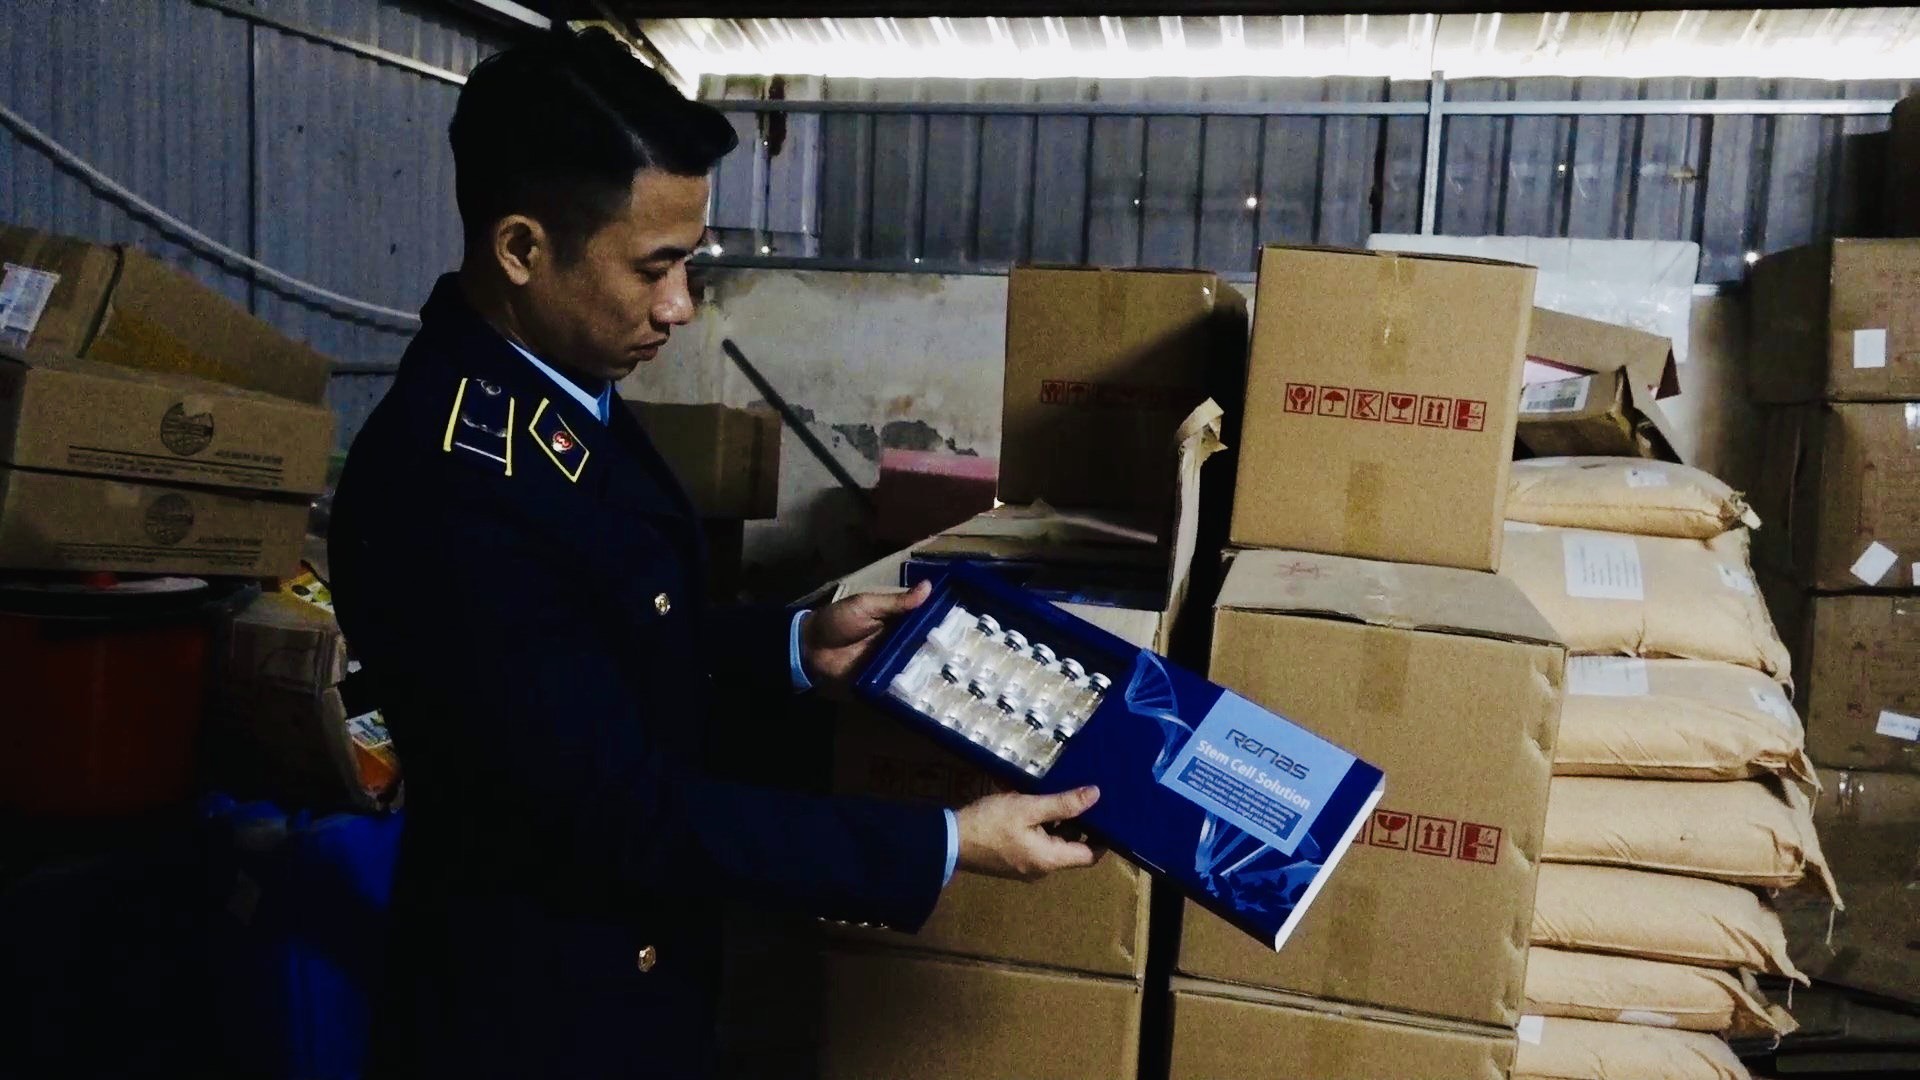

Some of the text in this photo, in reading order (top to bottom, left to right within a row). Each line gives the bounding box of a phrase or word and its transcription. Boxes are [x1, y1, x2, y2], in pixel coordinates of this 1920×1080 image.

[1196, 740, 1311, 810] Stem Cell Solution
